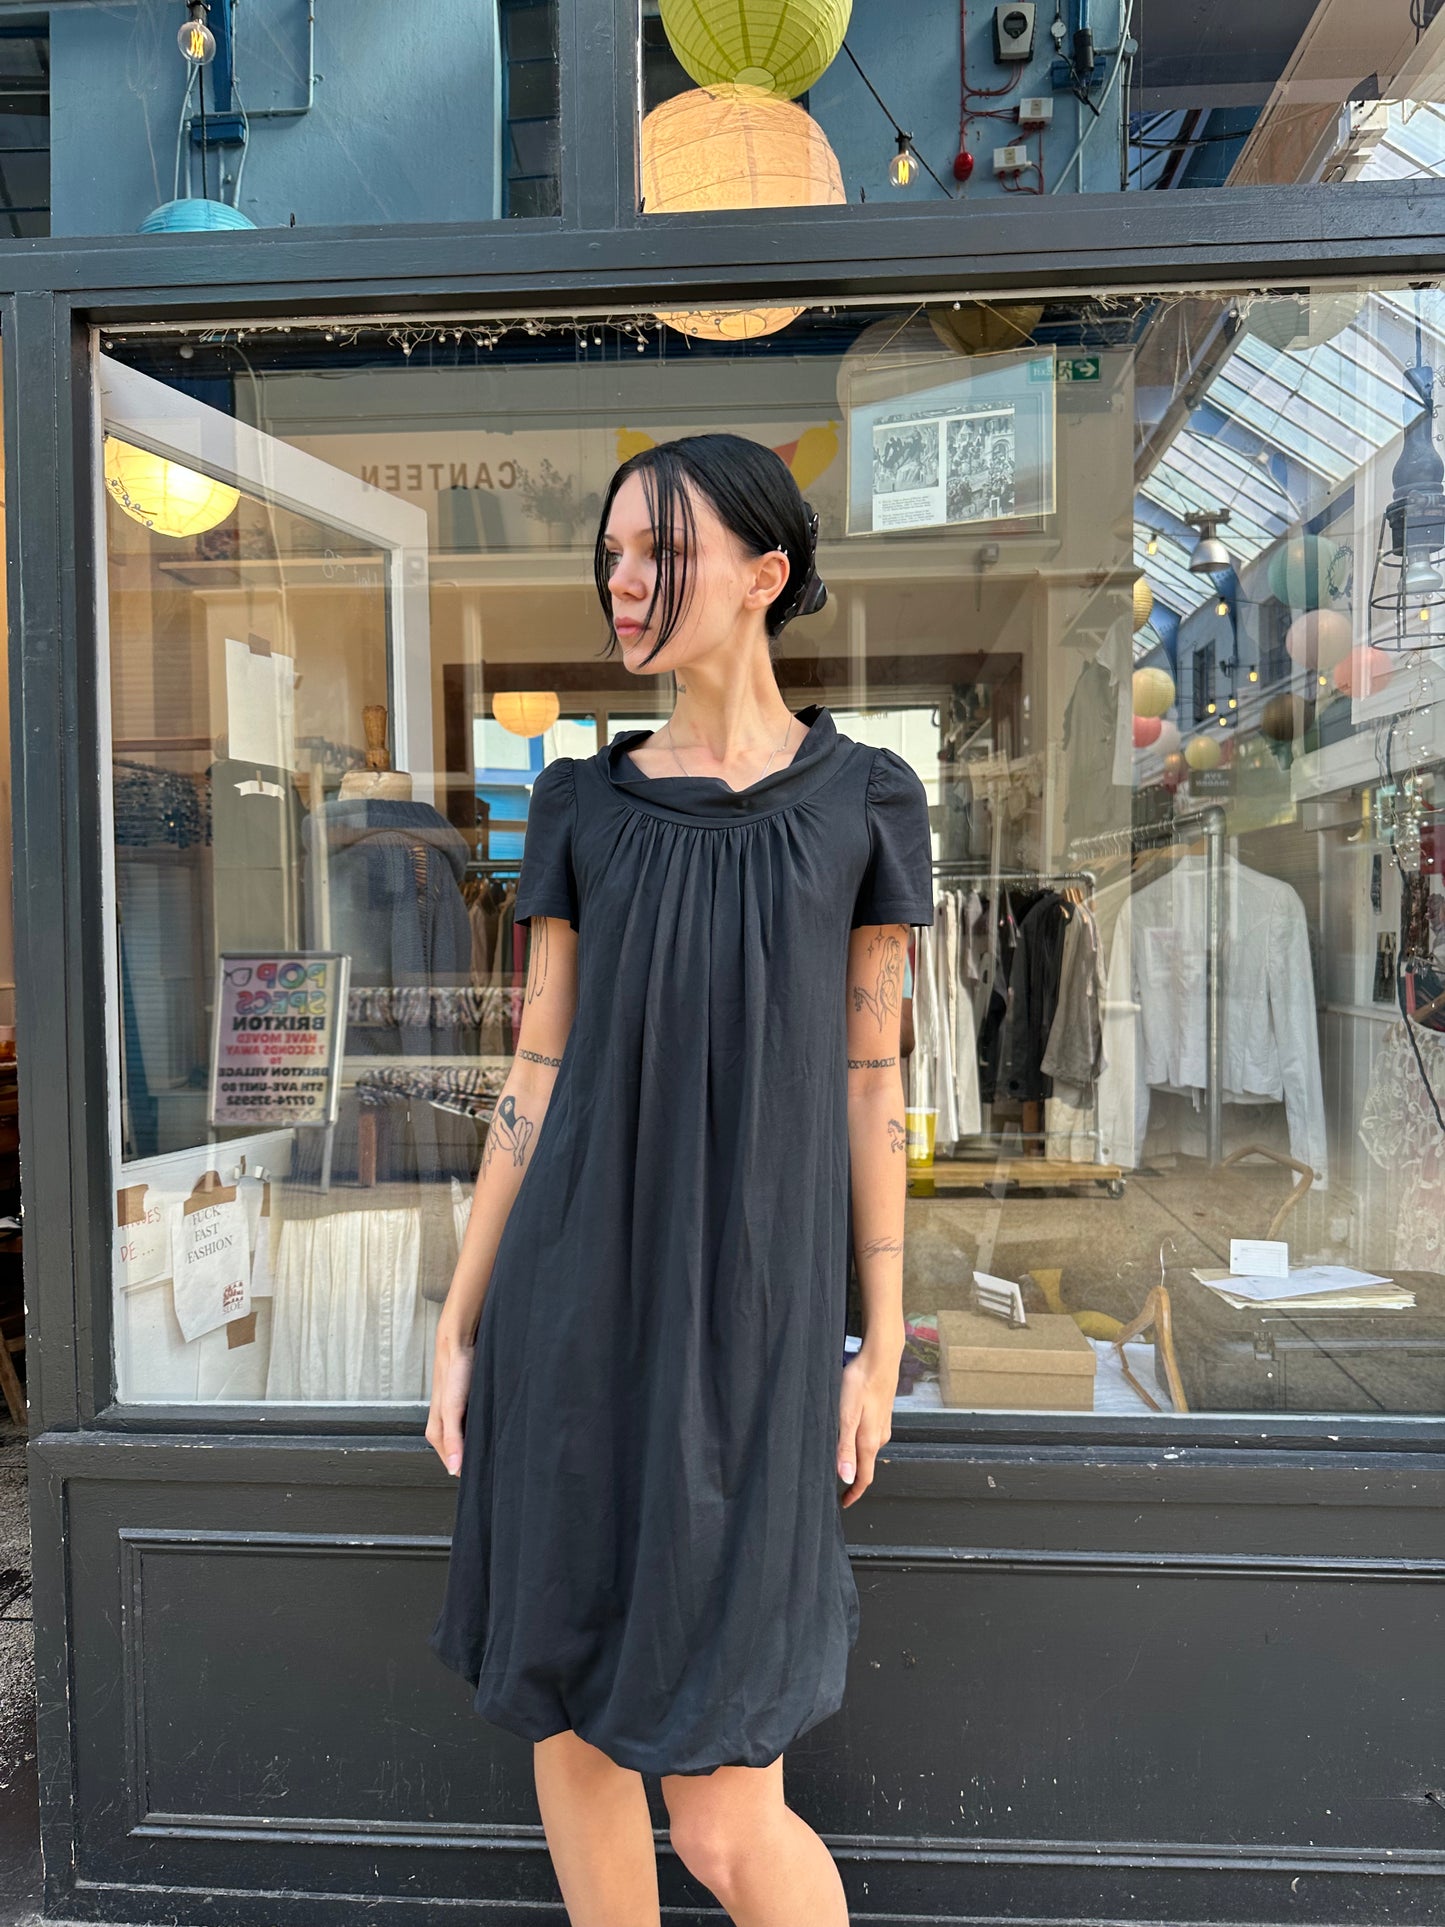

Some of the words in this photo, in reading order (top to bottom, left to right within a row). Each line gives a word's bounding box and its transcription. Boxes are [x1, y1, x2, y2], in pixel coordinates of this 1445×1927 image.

[192, 1204, 221, 1226] FUCK
[194, 1222, 219, 1242] FAST
[120, 1240, 137, 1263] DE
[187, 1234, 233, 1264] FASHION
